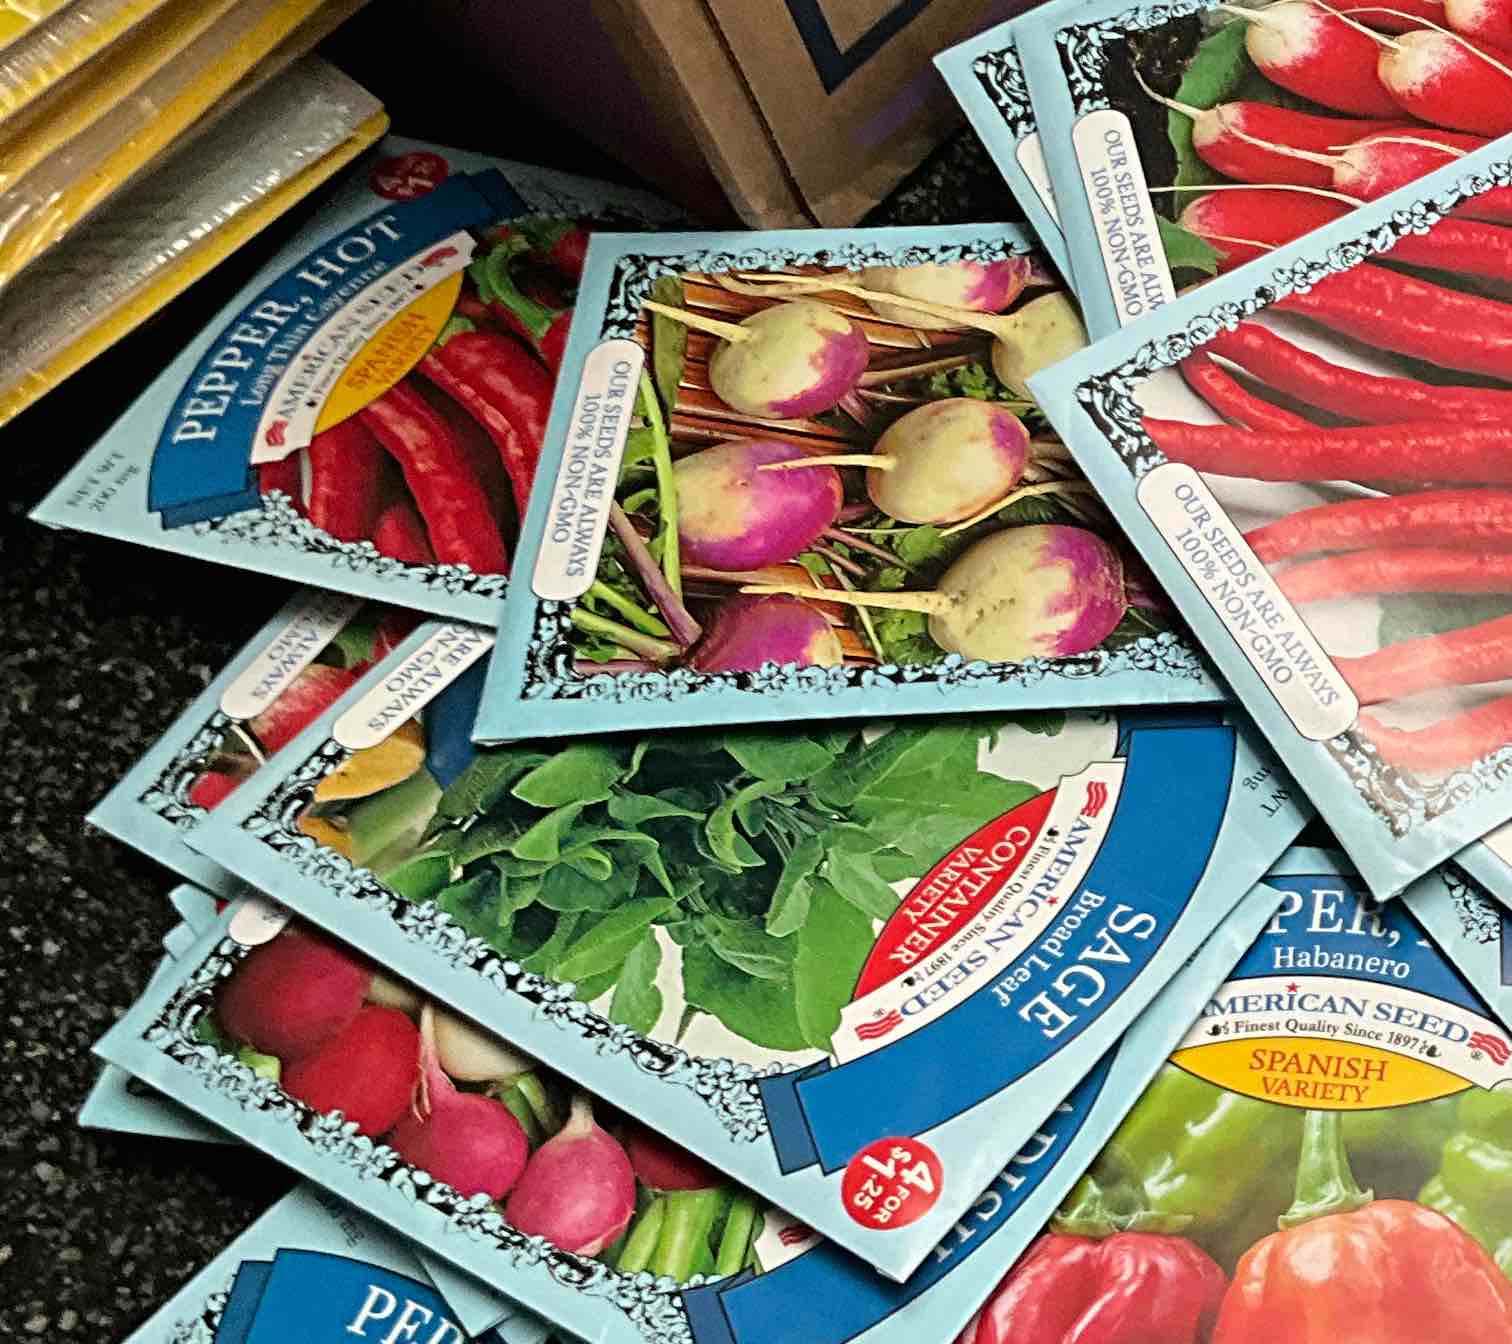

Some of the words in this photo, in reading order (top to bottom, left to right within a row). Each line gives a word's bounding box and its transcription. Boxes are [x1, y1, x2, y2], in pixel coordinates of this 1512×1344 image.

[172, 296, 314, 444] PEPPER,
[296, 215, 401, 288] HOT
[607, 360, 632, 399] OUR
[593, 404, 622, 460] SEEDS
[584, 462, 608, 499] ARE
[566, 504, 596, 578] ALWAYS
[1174, 483, 1213, 529] OUR
[1204, 527, 1256, 587] SEEDS
[1247, 589, 1284, 629] ARE
[1275, 631, 1340, 707] ALWAYS
[1175, 527, 1220, 579] 100%
[1212, 580, 1293, 684] NON-GMO
[889, 825, 1031, 966] CONTAINER
[905, 847, 985, 925] VARIETY
[990, 815, 1088, 953] AMERICAN
[1039, 888, 1105, 956] Broad
[899, 951, 989, 1018] SEED
[993, 949, 1042, 1008] Leaf
[1019, 902, 1157, 1041] SAGE
[1273, 944, 1410, 979] Habanero
[1235, 1019, 1282, 1033] Finest
[1284, 1019, 1340, 1038] Quality
[1344, 1023, 1383, 1039] Since
[1387, 1032, 1419, 1049] 1897
[1248, 1048, 1389, 1083] SPANISH
[1261, 1076, 1370, 1103] VARIETY
[874, 1185, 910, 1225] FOR
[900, 1168, 935, 1196] 4
